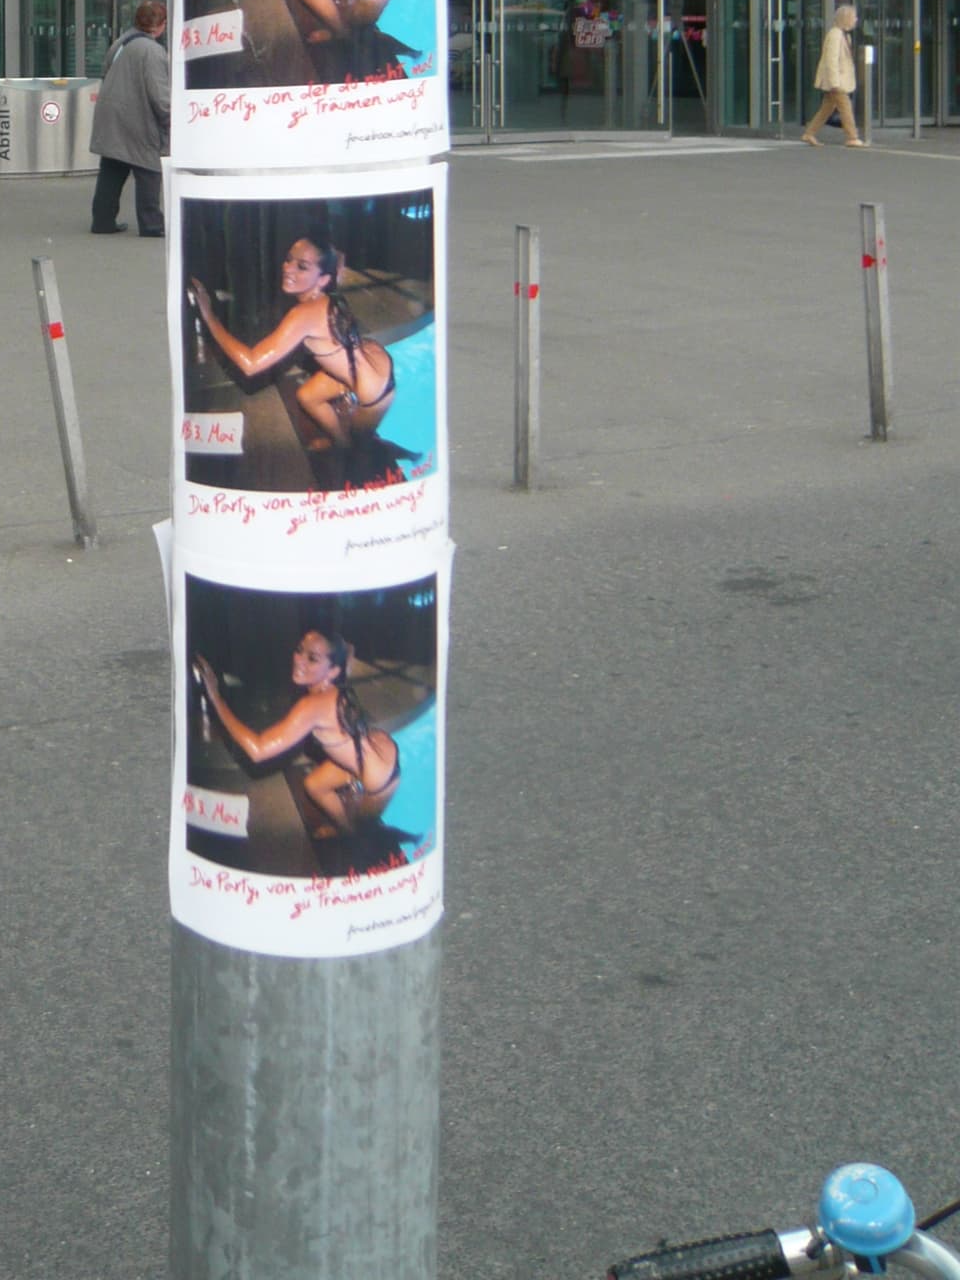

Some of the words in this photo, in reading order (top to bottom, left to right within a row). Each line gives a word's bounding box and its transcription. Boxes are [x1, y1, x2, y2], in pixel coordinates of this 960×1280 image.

[187, 102, 210, 124] Die
[263, 91, 294, 105] von
[300, 80, 330, 99] der
[187, 494, 210, 516] Die
[262, 497, 293, 511] von
[300, 488, 329, 506] der
[190, 866, 212, 889] Die
[266, 882, 297, 895] von
[304, 871, 333, 892] der
